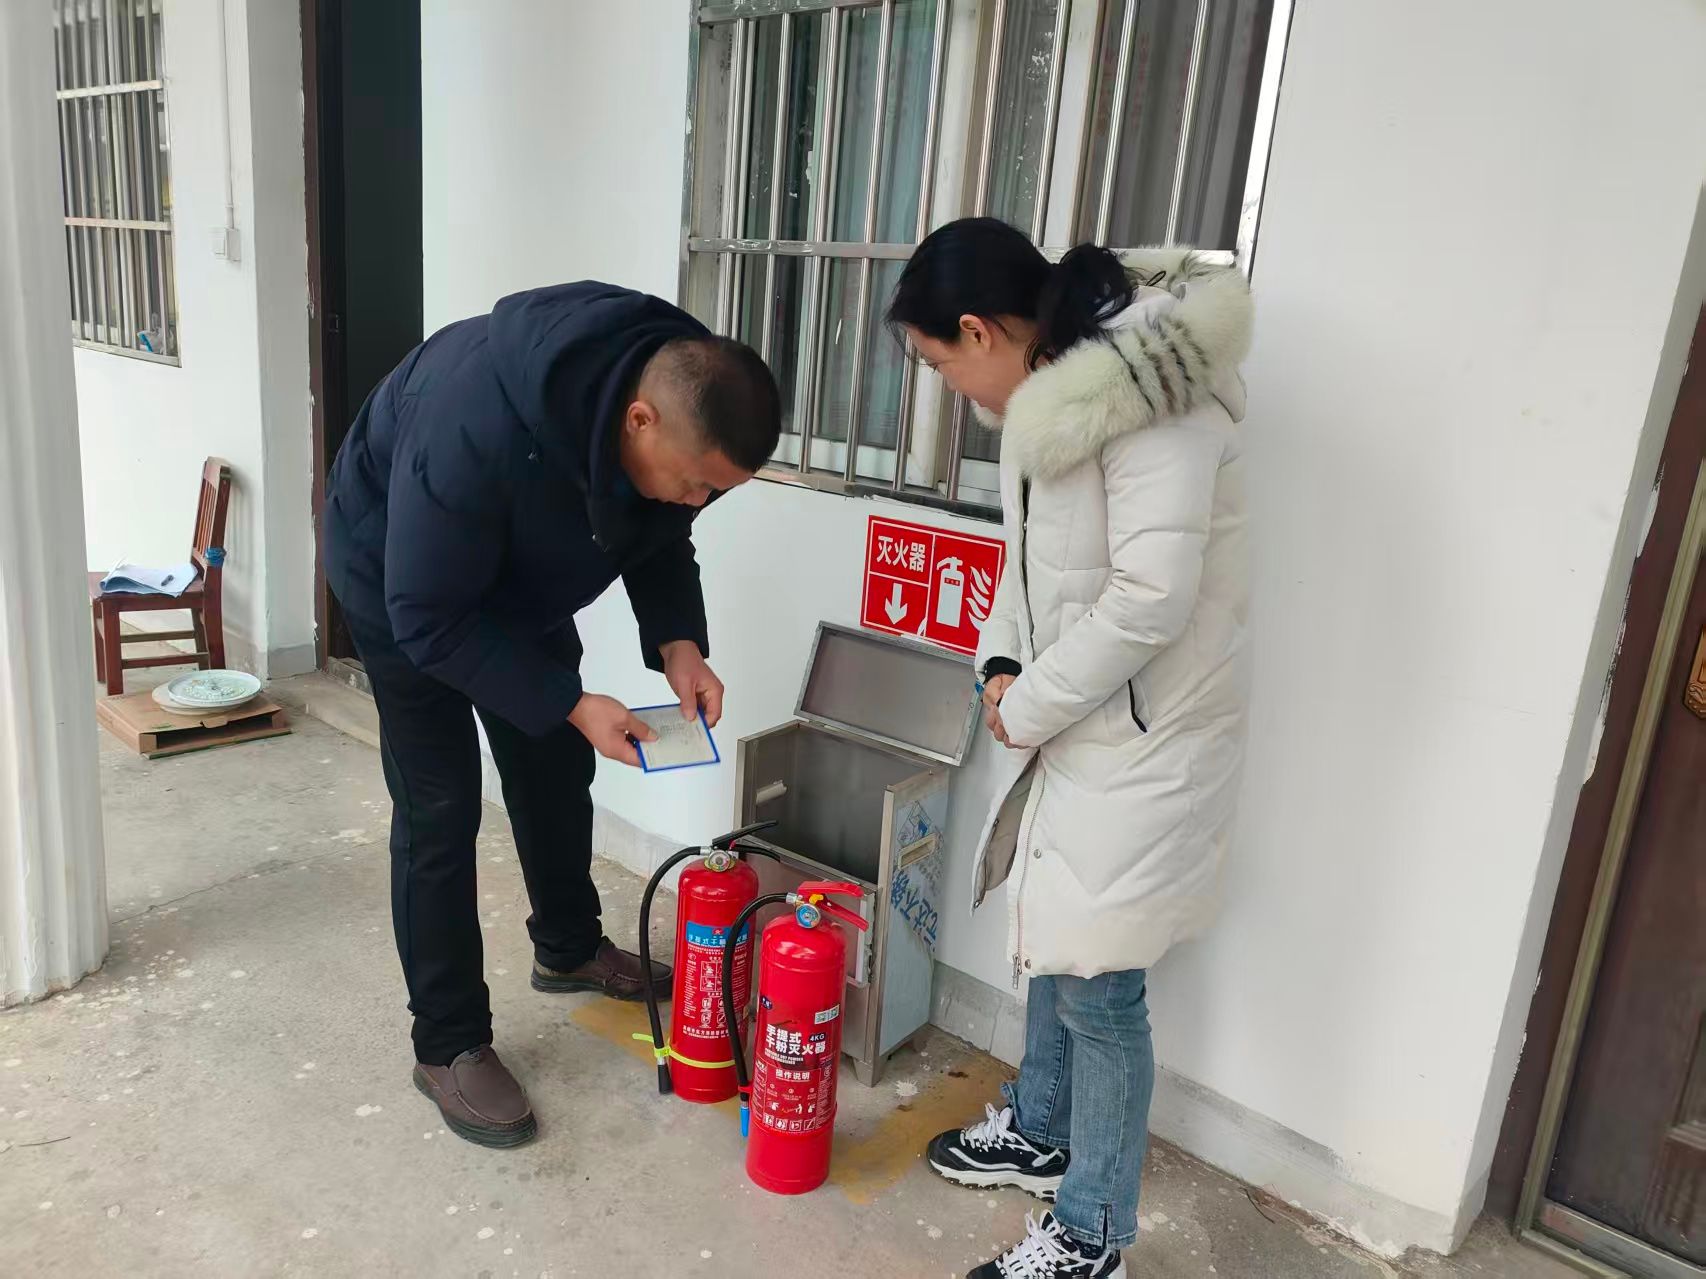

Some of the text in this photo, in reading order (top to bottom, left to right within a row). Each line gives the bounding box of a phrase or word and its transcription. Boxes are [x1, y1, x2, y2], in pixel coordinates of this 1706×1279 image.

[876, 535, 926, 572] 灭火器
[767, 1023, 802, 1044] 手提式
[810, 1033, 825, 1042] 4KG
[765, 1035, 826, 1055] 干粉灭火器
[776, 1068, 810, 1080] 操作说明
